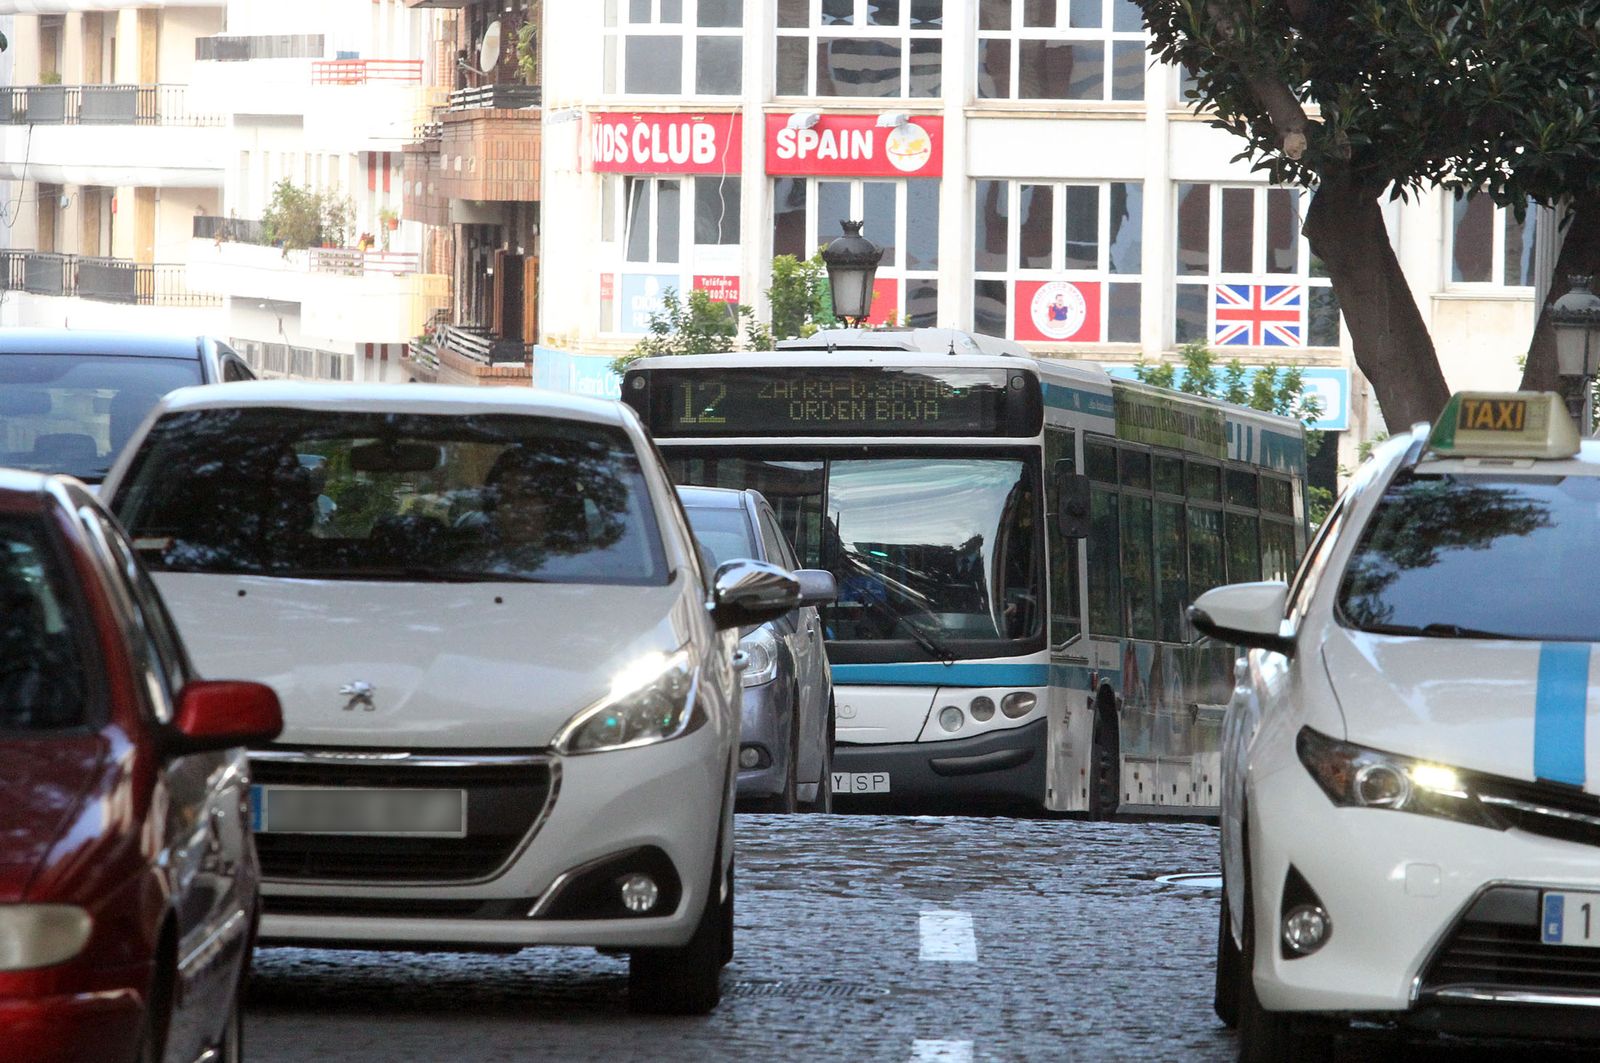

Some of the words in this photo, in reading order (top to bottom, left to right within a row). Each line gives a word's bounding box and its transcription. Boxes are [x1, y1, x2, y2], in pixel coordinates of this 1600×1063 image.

[592, 123, 629, 164] KIDS
[631, 122, 717, 165] CLUB
[776, 128, 874, 160] SPAIN
[679, 379, 727, 424] 12
[789, 400, 867, 421] ORDEN
[875, 400, 939, 421] BAJA
[1464, 400, 1524, 429] TAXI
